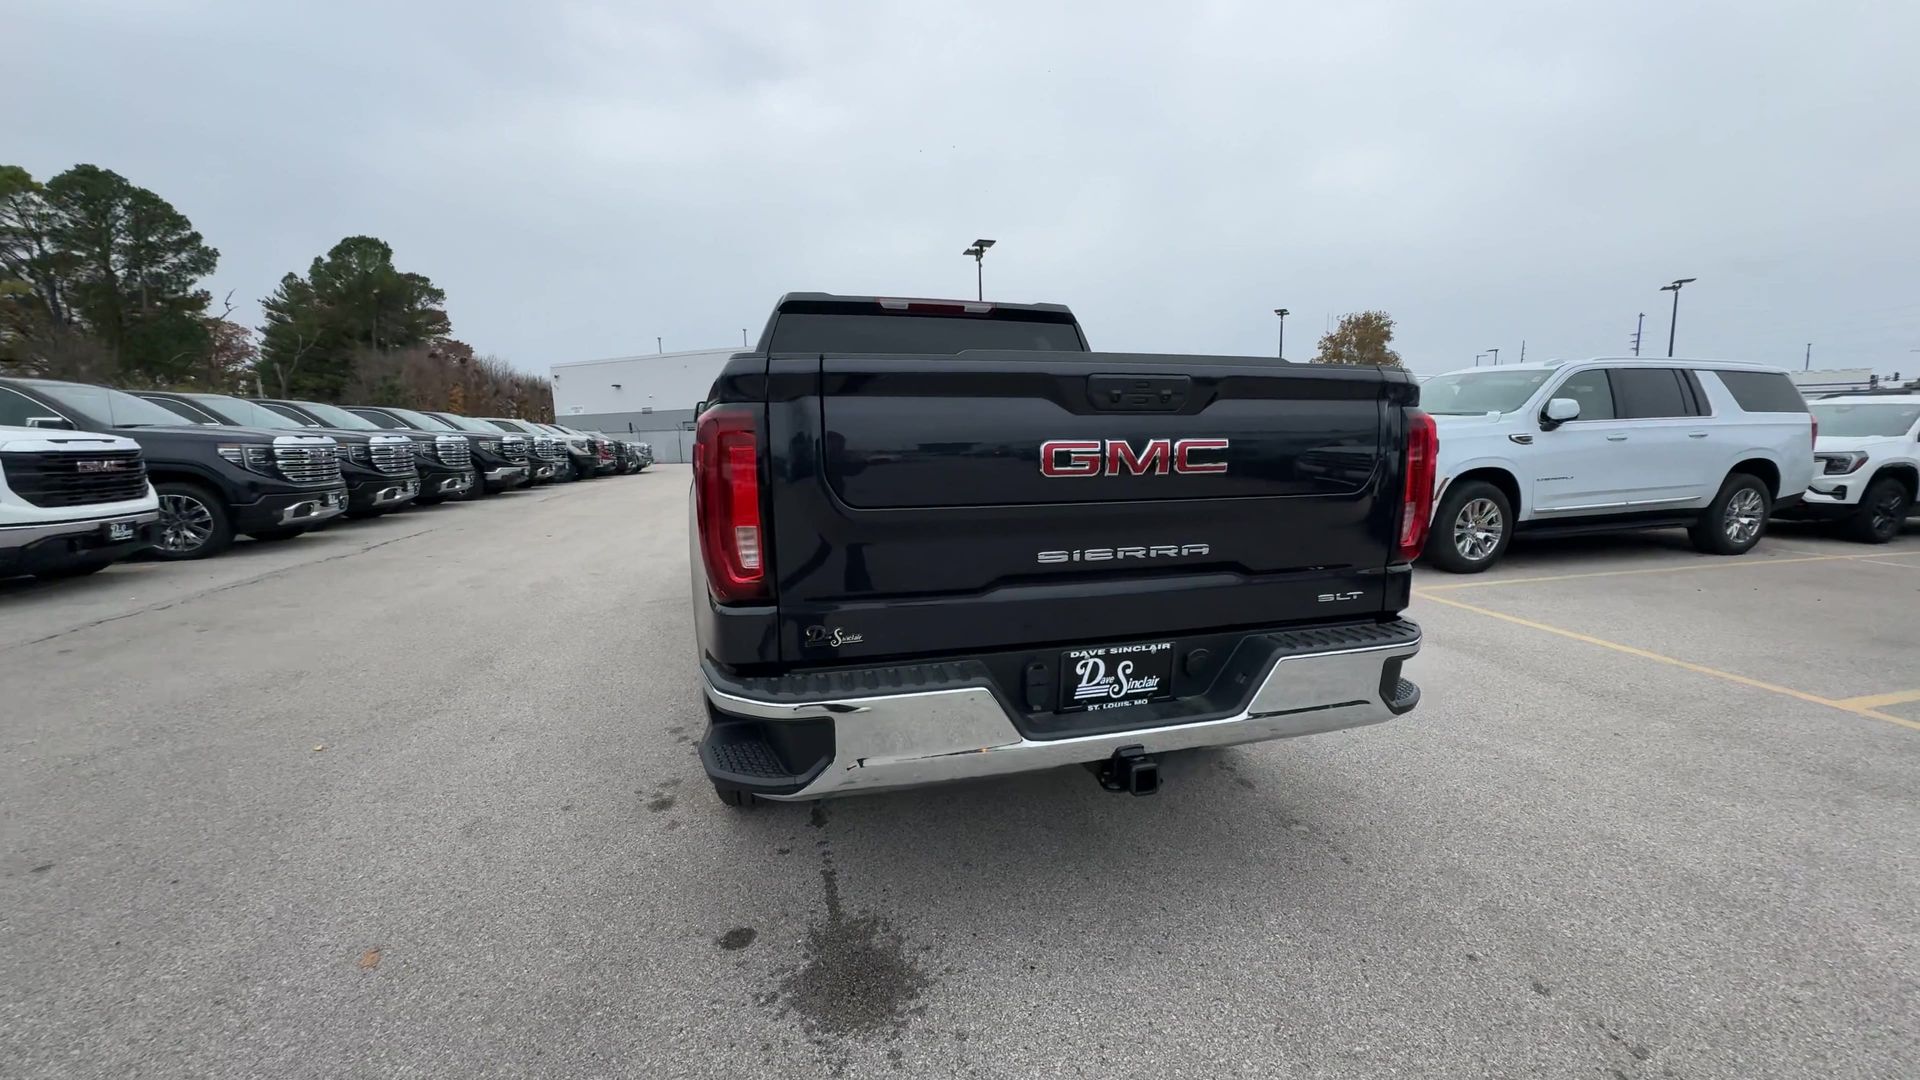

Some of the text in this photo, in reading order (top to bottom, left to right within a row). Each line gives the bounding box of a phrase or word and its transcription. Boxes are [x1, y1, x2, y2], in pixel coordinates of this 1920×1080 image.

[1040, 438, 1229, 477] GMC
[1037, 543, 1210, 563] SIERRA
[1317, 591, 1364, 602] SLT
[1070, 643, 1171, 658] DAVE SINCLAIR
[1075, 657, 1160, 698] Dave Sinclair
